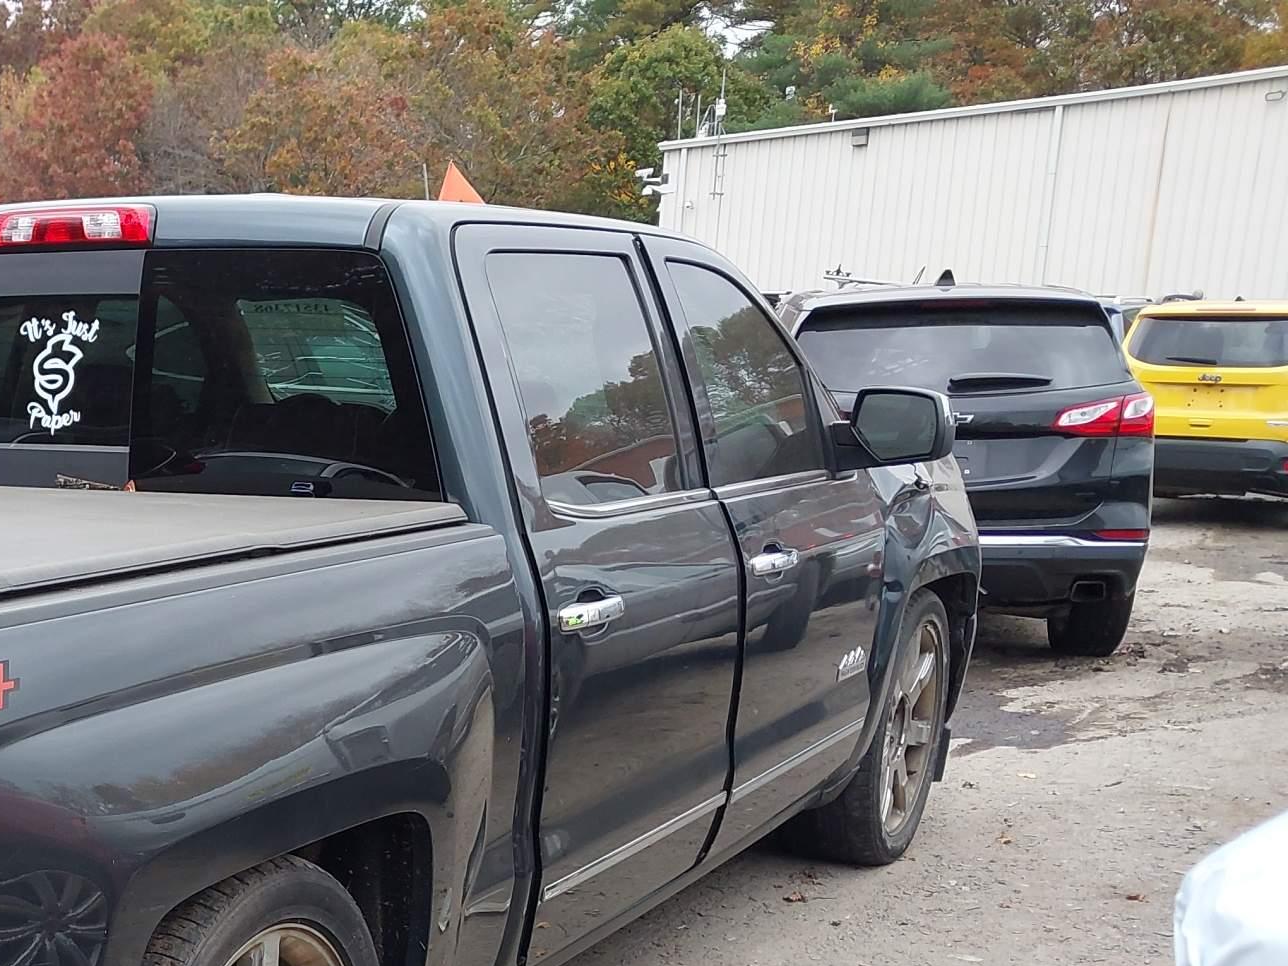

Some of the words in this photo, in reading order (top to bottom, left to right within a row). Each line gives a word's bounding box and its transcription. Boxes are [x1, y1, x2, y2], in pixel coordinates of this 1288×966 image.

[19, 317, 56, 342] It's
[60, 310, 100, 343] Just
[1197, 374, 1223, 384] Jeep
[26, 401, 81, 436] Paper
